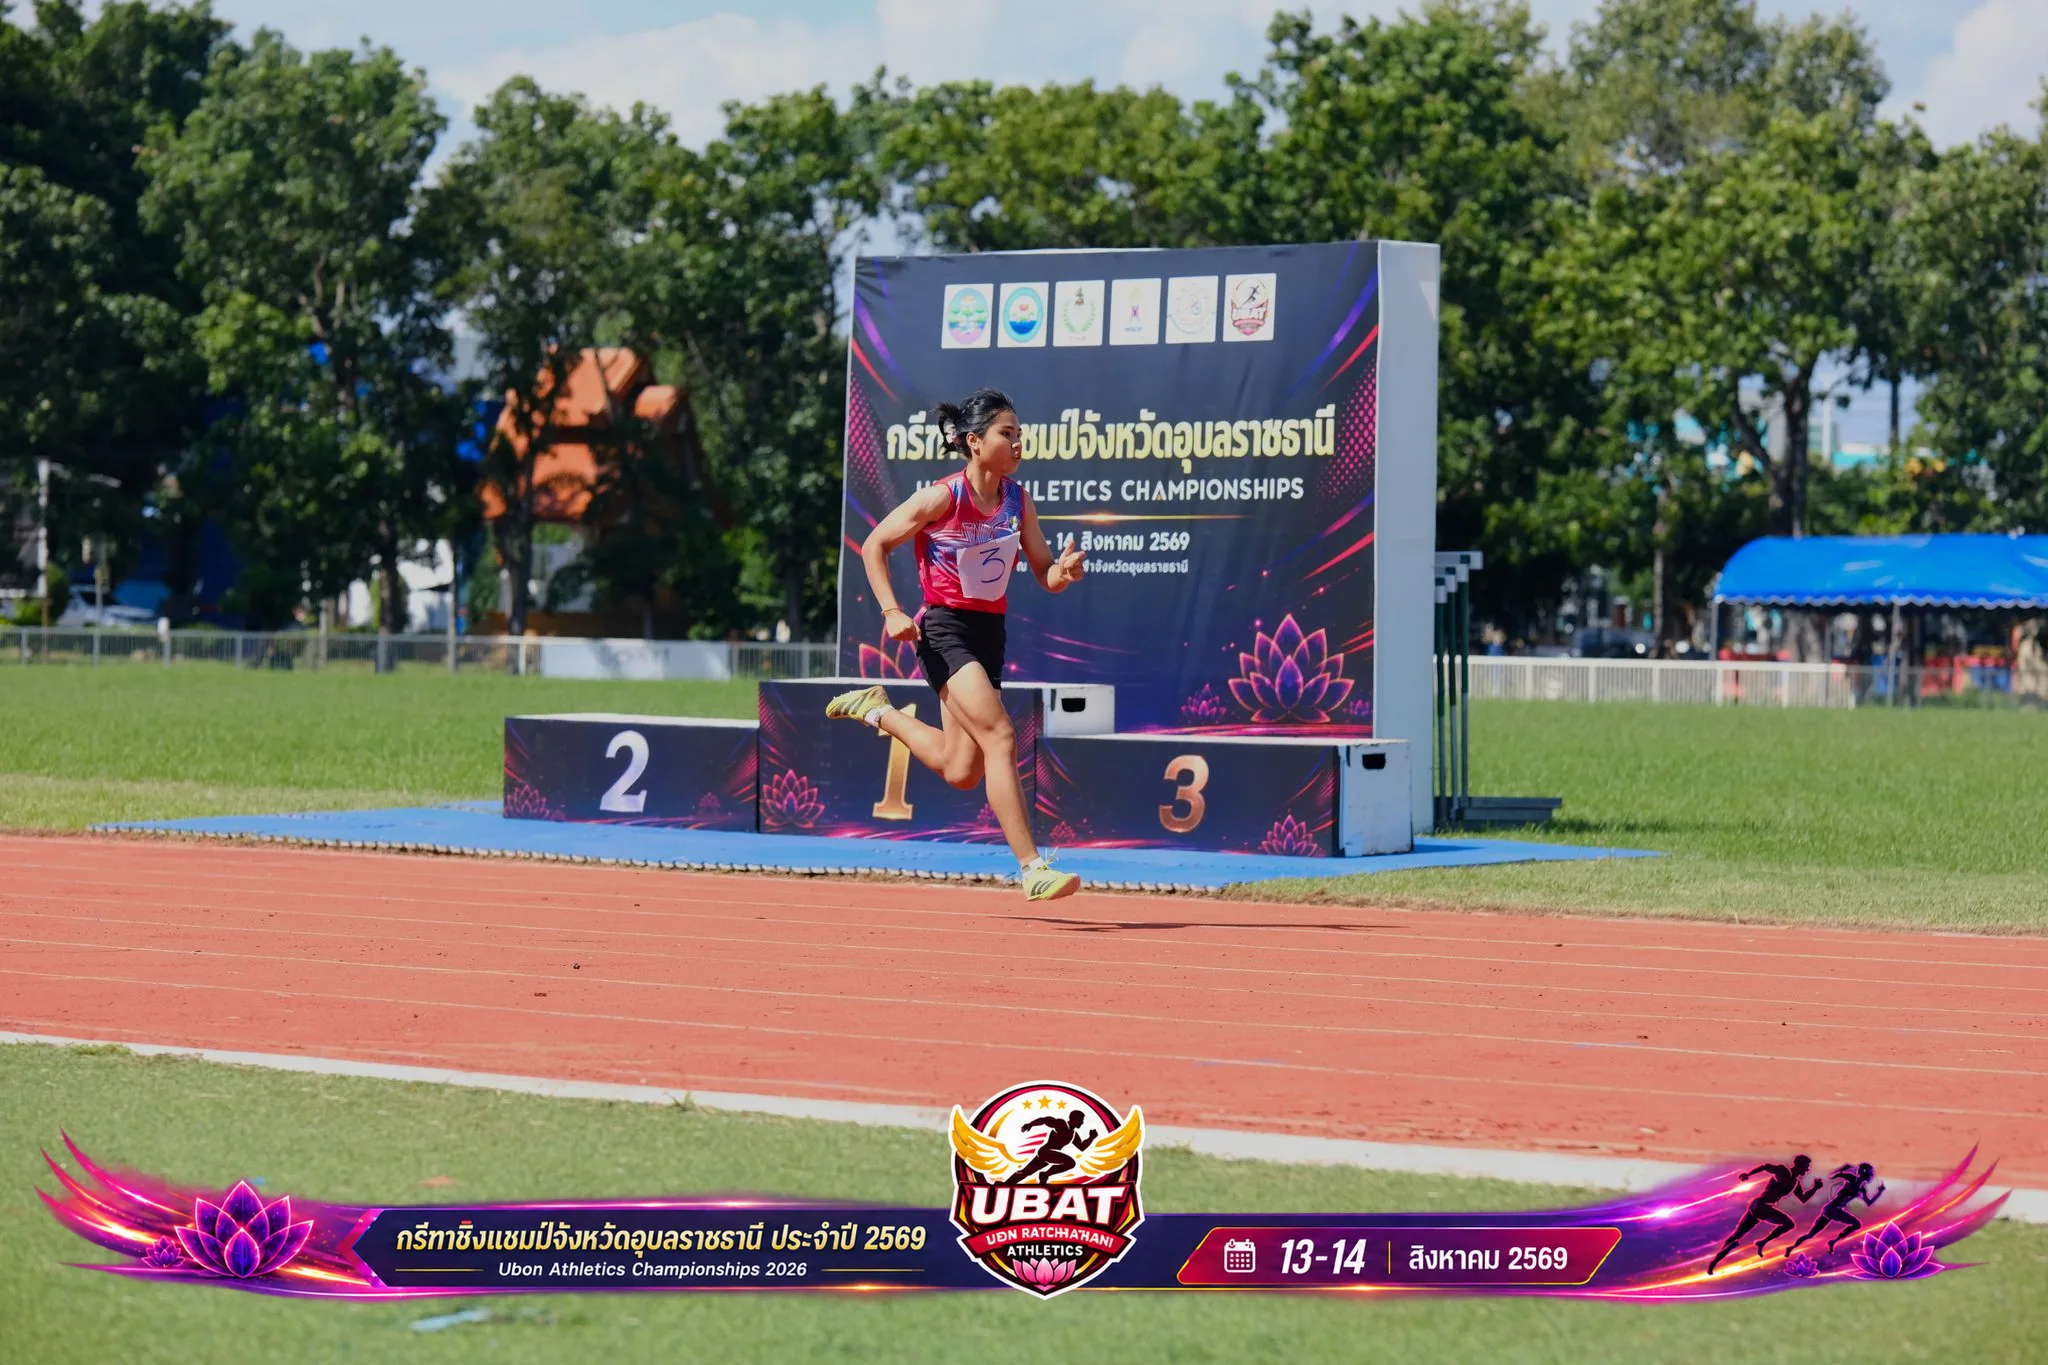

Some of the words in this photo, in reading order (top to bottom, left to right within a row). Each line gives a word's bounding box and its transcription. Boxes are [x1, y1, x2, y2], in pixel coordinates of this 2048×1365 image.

[1017, 479, 1112, 502] LETICS
[1121, 477, 1304, 501] CHAMPIONSHIPS
[979, 547, 1006, 584] 3
[1081, 531, 1144, 551] สิงหาคม
[1149, 531, 1191, 551] 2569
[600, 730, 650, 813] 2
[872, 703, 917, 820] 1
[1158, 754, 1210, 833] 3
